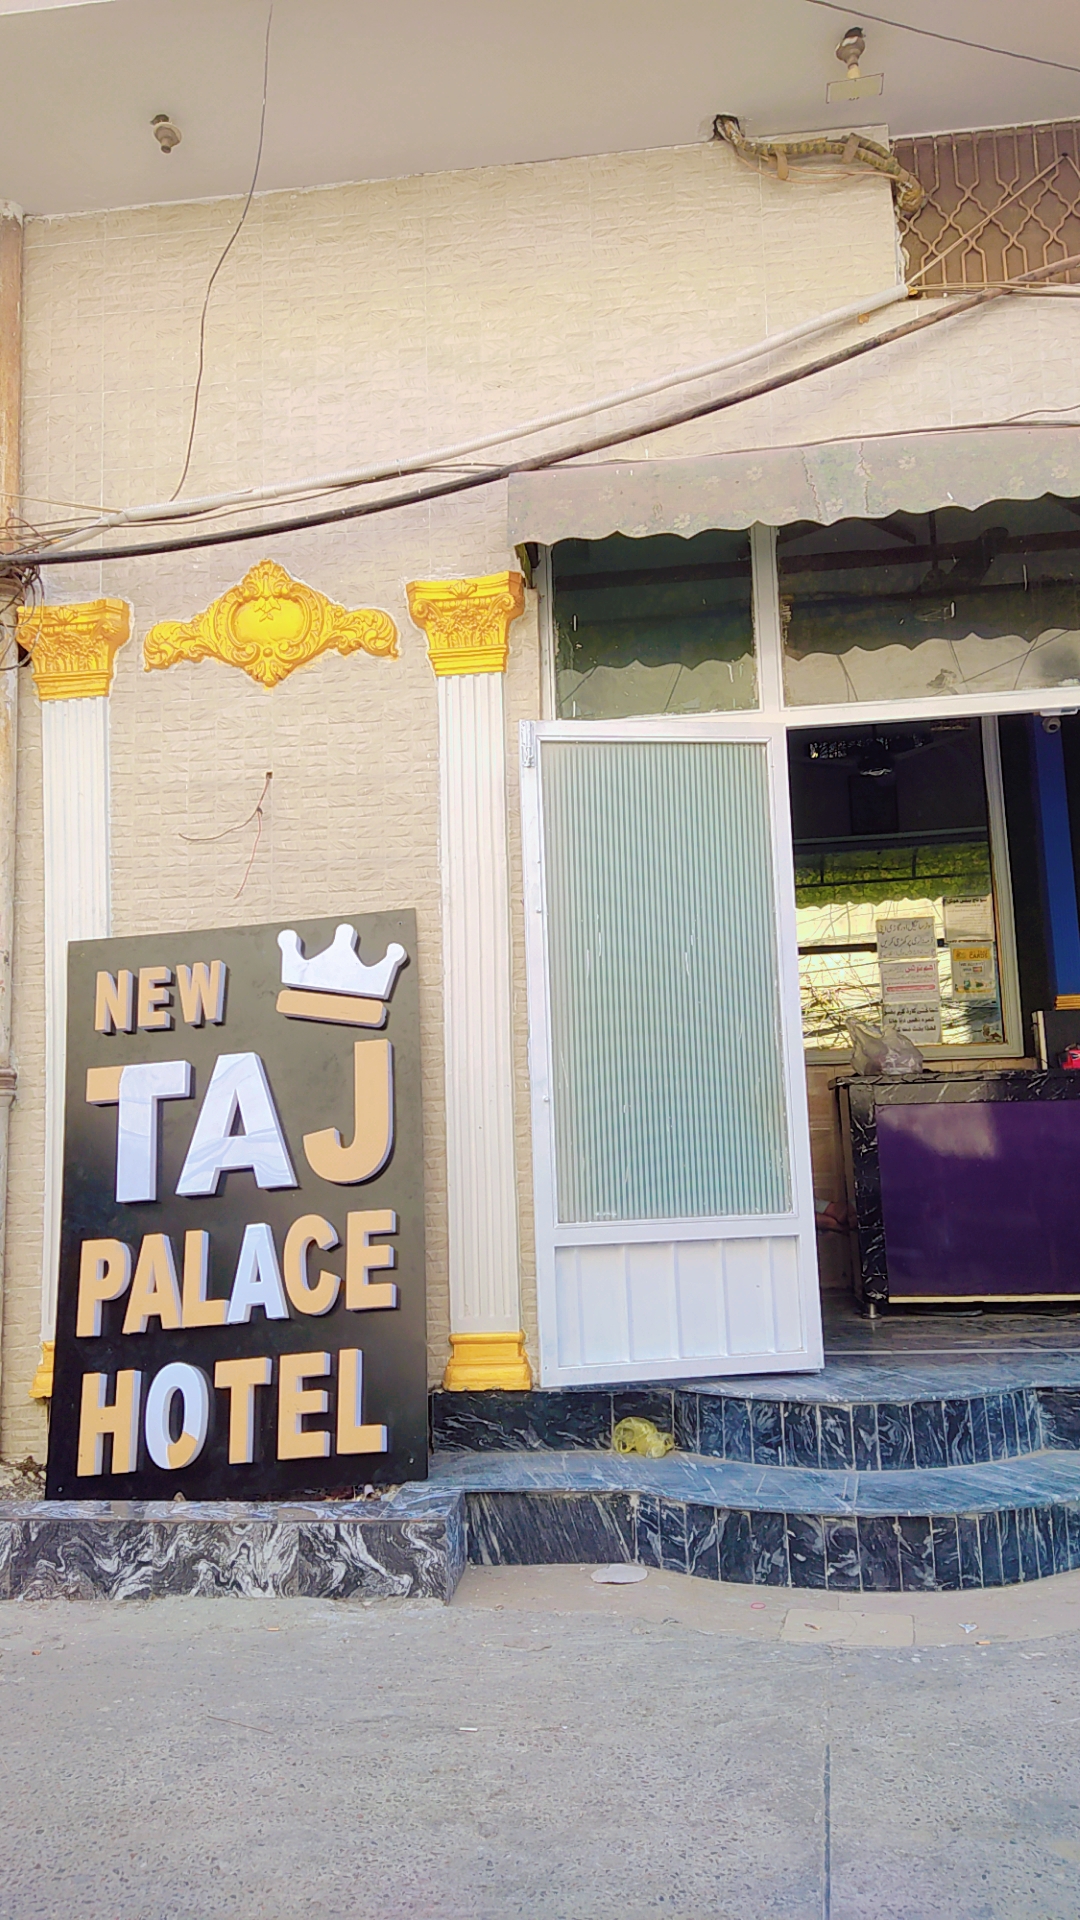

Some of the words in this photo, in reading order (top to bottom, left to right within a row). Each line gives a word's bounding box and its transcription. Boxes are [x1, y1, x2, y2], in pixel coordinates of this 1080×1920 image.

[94, 960, 227, 1034] NEW
[86, 1038, 393, 1203] TAJ
[76, 1209, 397, 1338] PALACE
[76, 1348, 387, 1477] HOTEL
